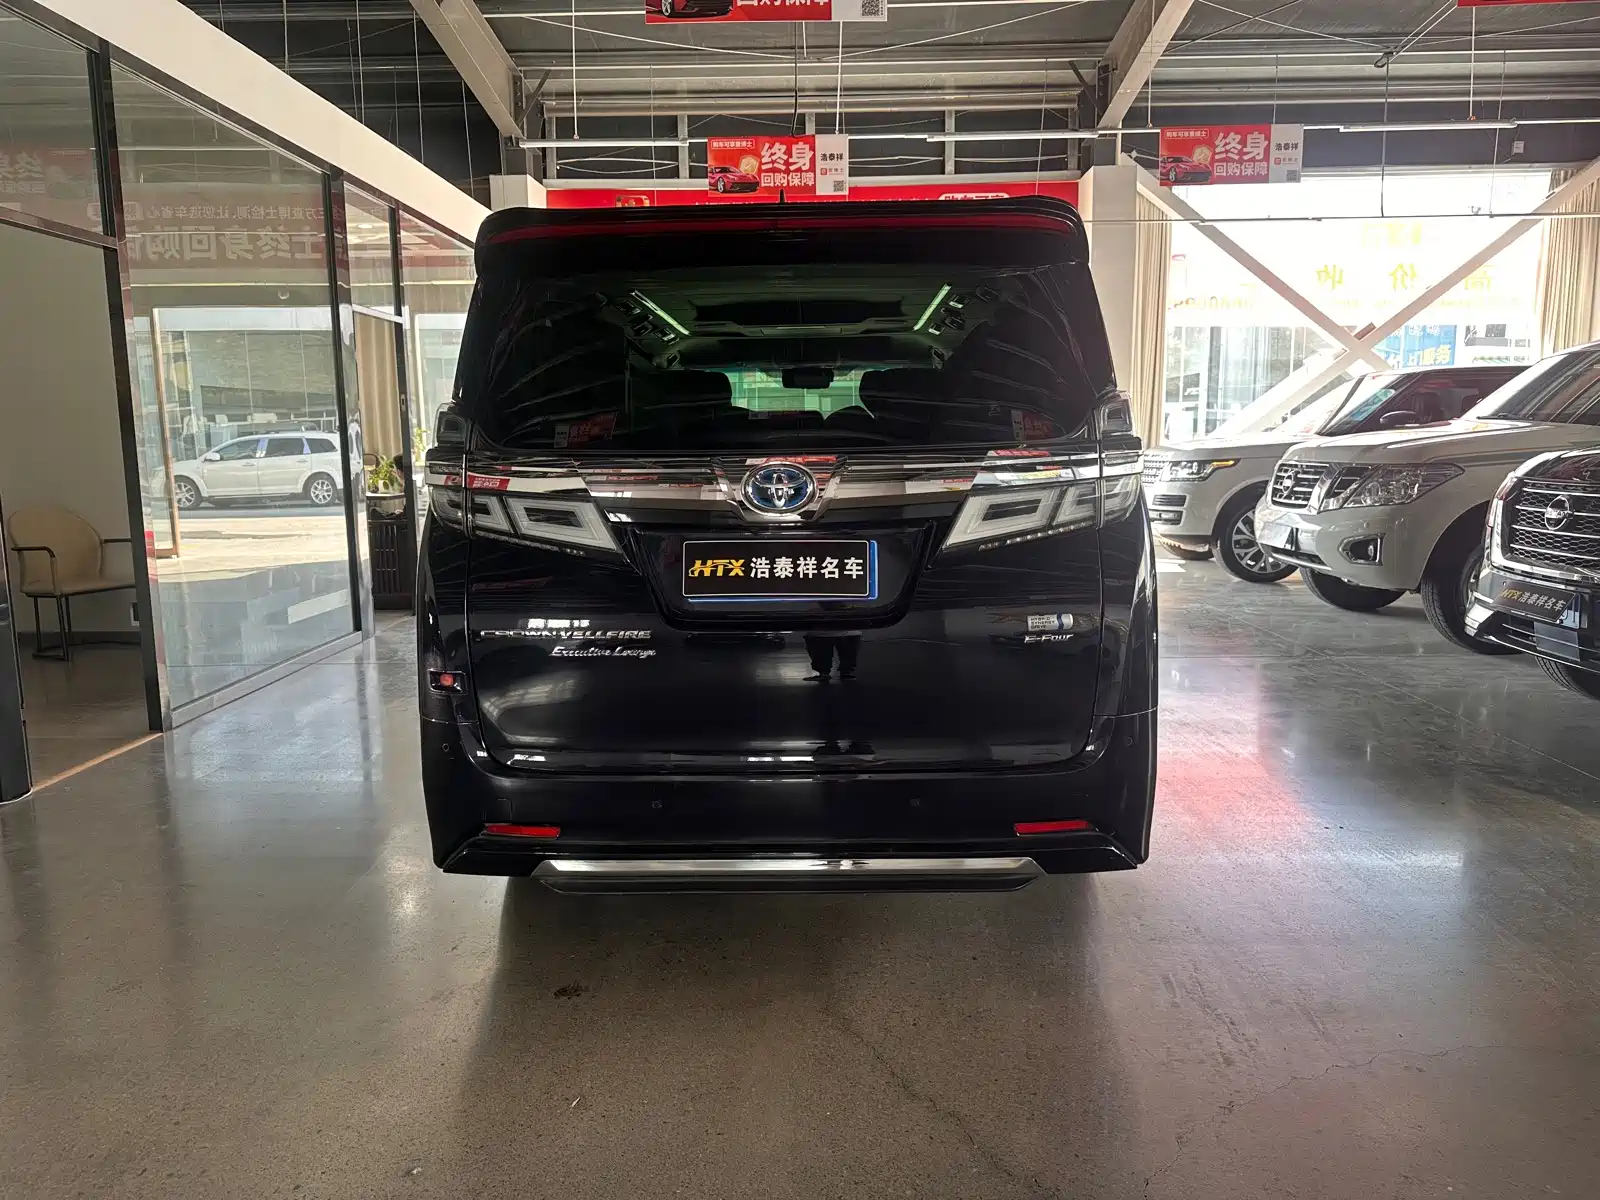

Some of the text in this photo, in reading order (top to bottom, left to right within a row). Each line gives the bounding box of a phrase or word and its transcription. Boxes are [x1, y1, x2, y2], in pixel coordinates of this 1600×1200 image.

[1214, 131, 1268, 161] 终身
[761, 142, 814, 171] 终身
[1215, 162, 1268, 176] 回购保障
[761, 172, 815, 187] 回购保障
[688, 556, 864, 579] HTX 浩泰祥名车
[1499, 587, 1523, 600] HTX
[1518, 591, 1567, 612] 浩泰祥名车
[560, 630, 652, 639] VELLFIRE
[548, 645, 656, 660] Executive Lounge
